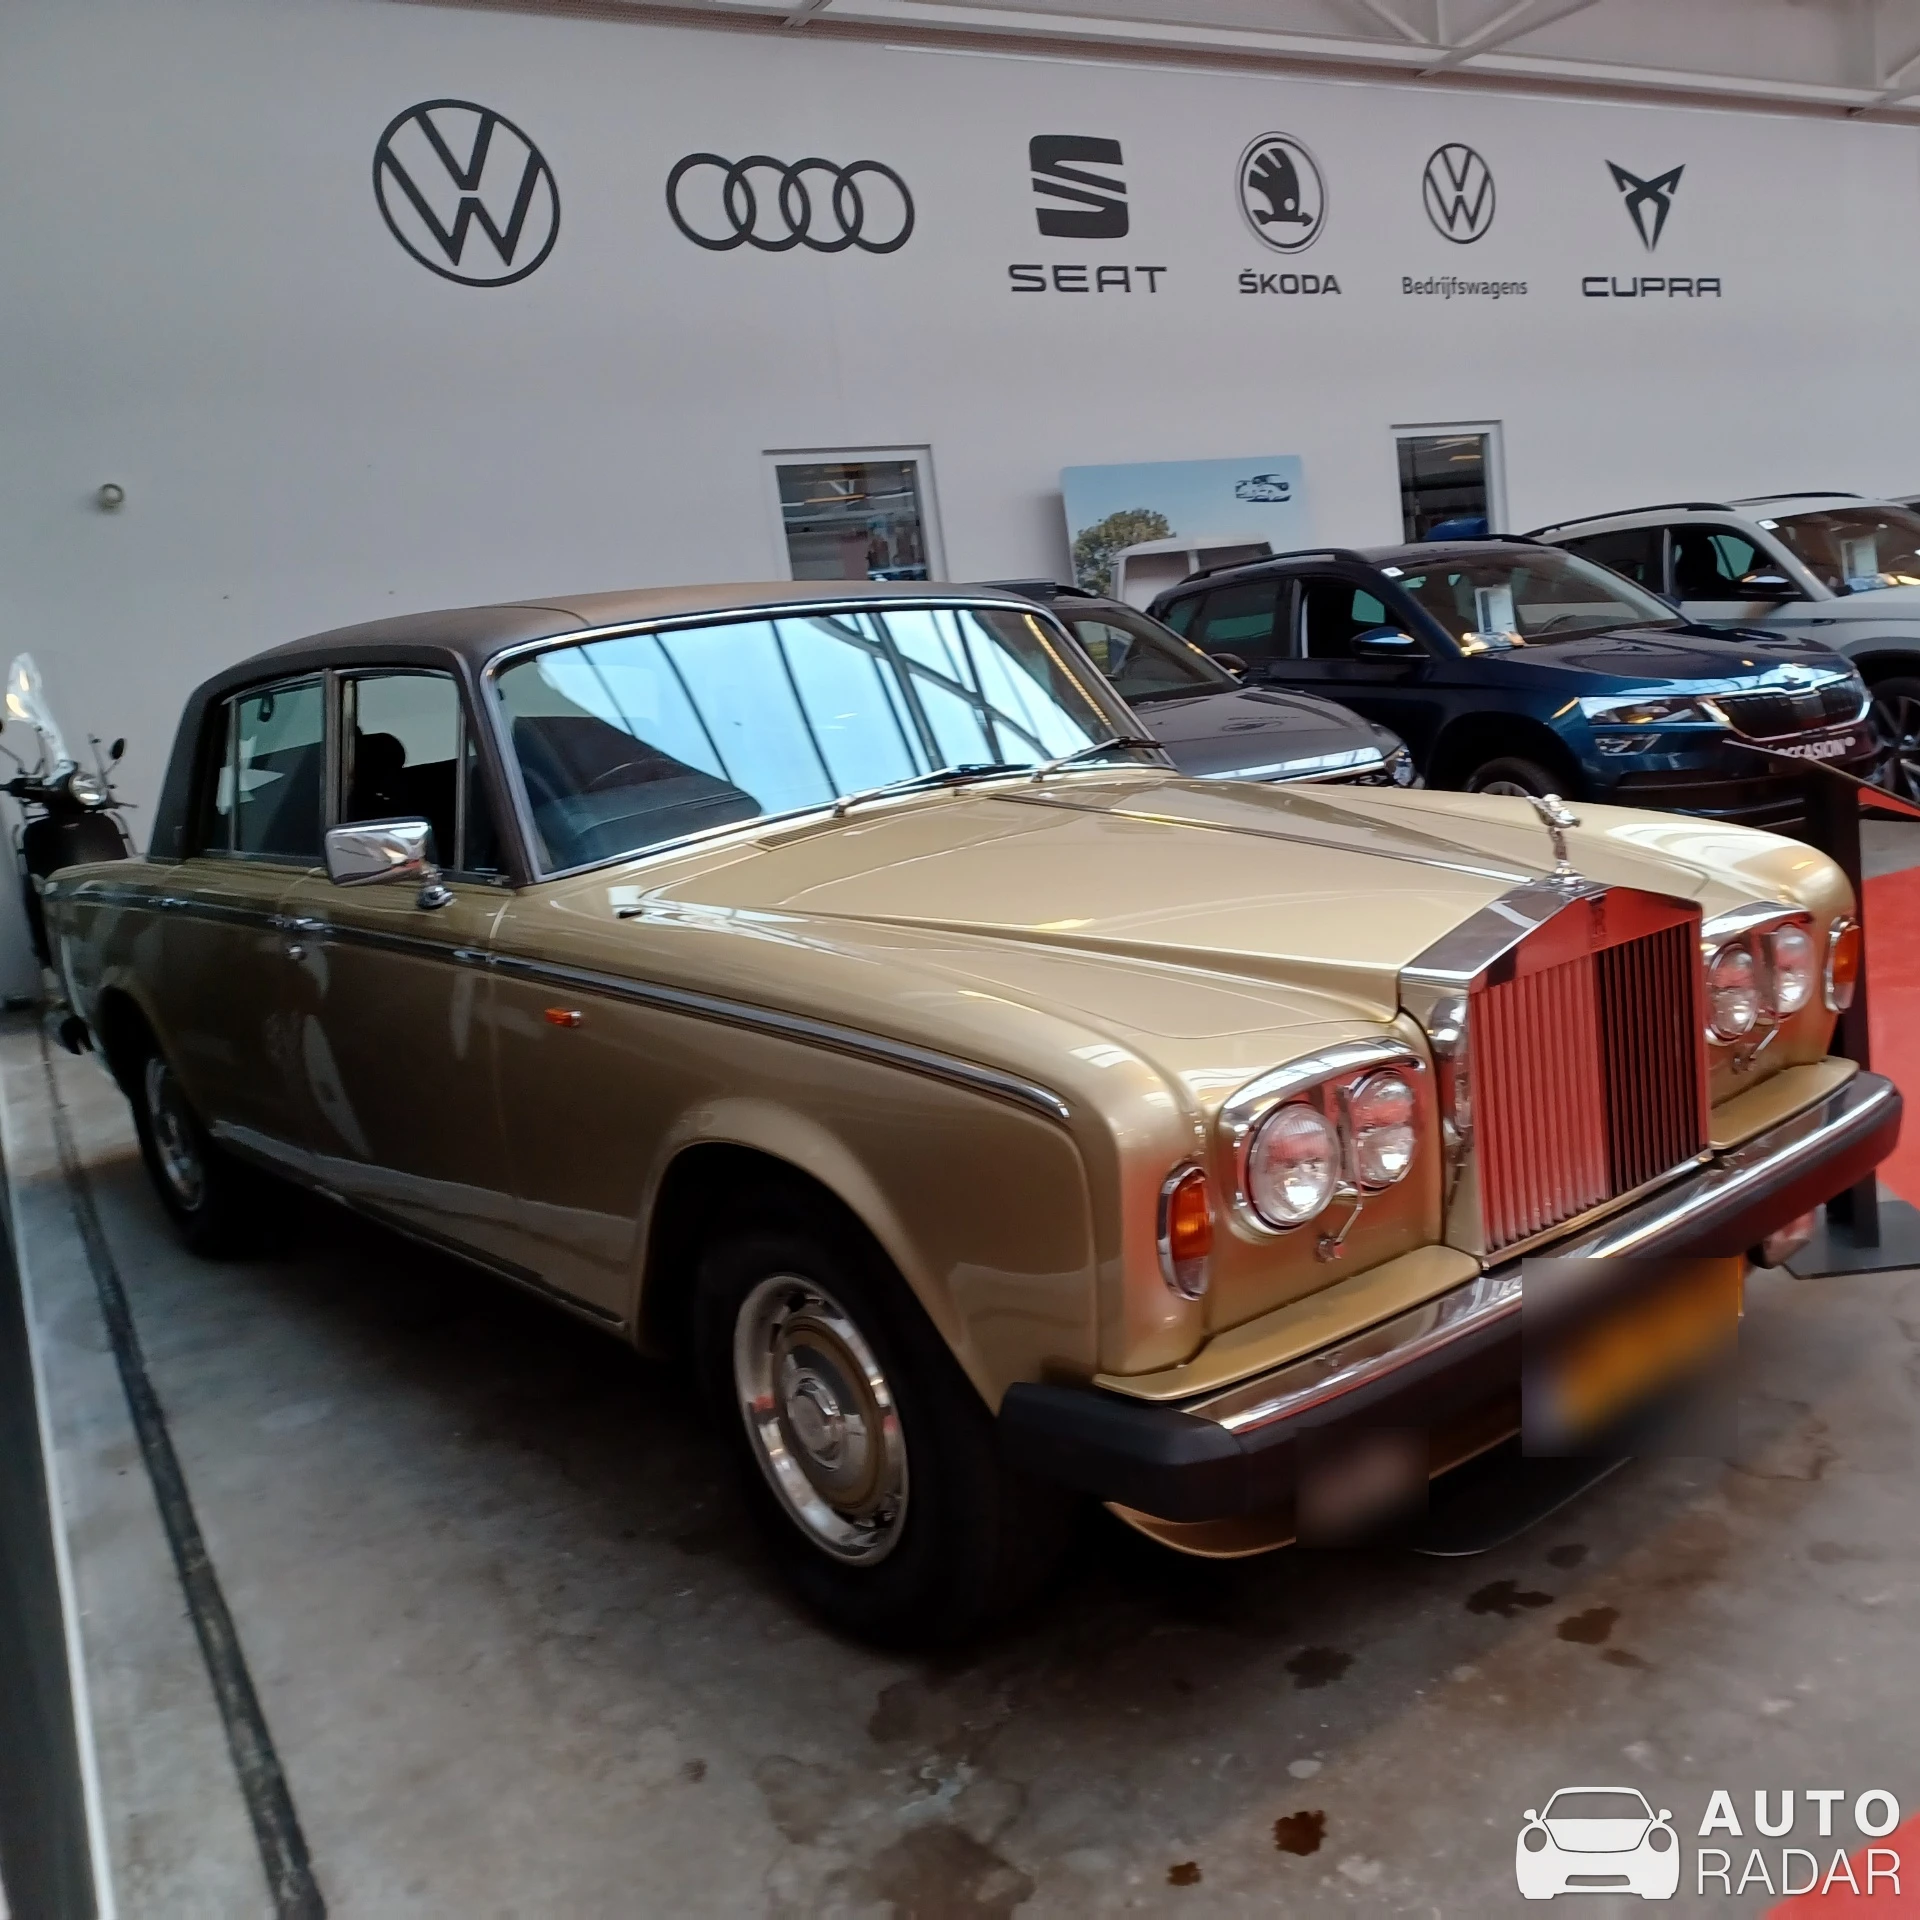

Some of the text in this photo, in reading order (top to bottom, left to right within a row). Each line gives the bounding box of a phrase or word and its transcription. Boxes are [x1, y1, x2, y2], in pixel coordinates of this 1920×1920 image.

[1008, 263, 1168, 293] SEAT
[1238, 268, 1342, 295] ŠKODA
[1401, 276, 1528, 300] Bedrijfswagens
[1582, 276, 1722, 298] CUPRA
